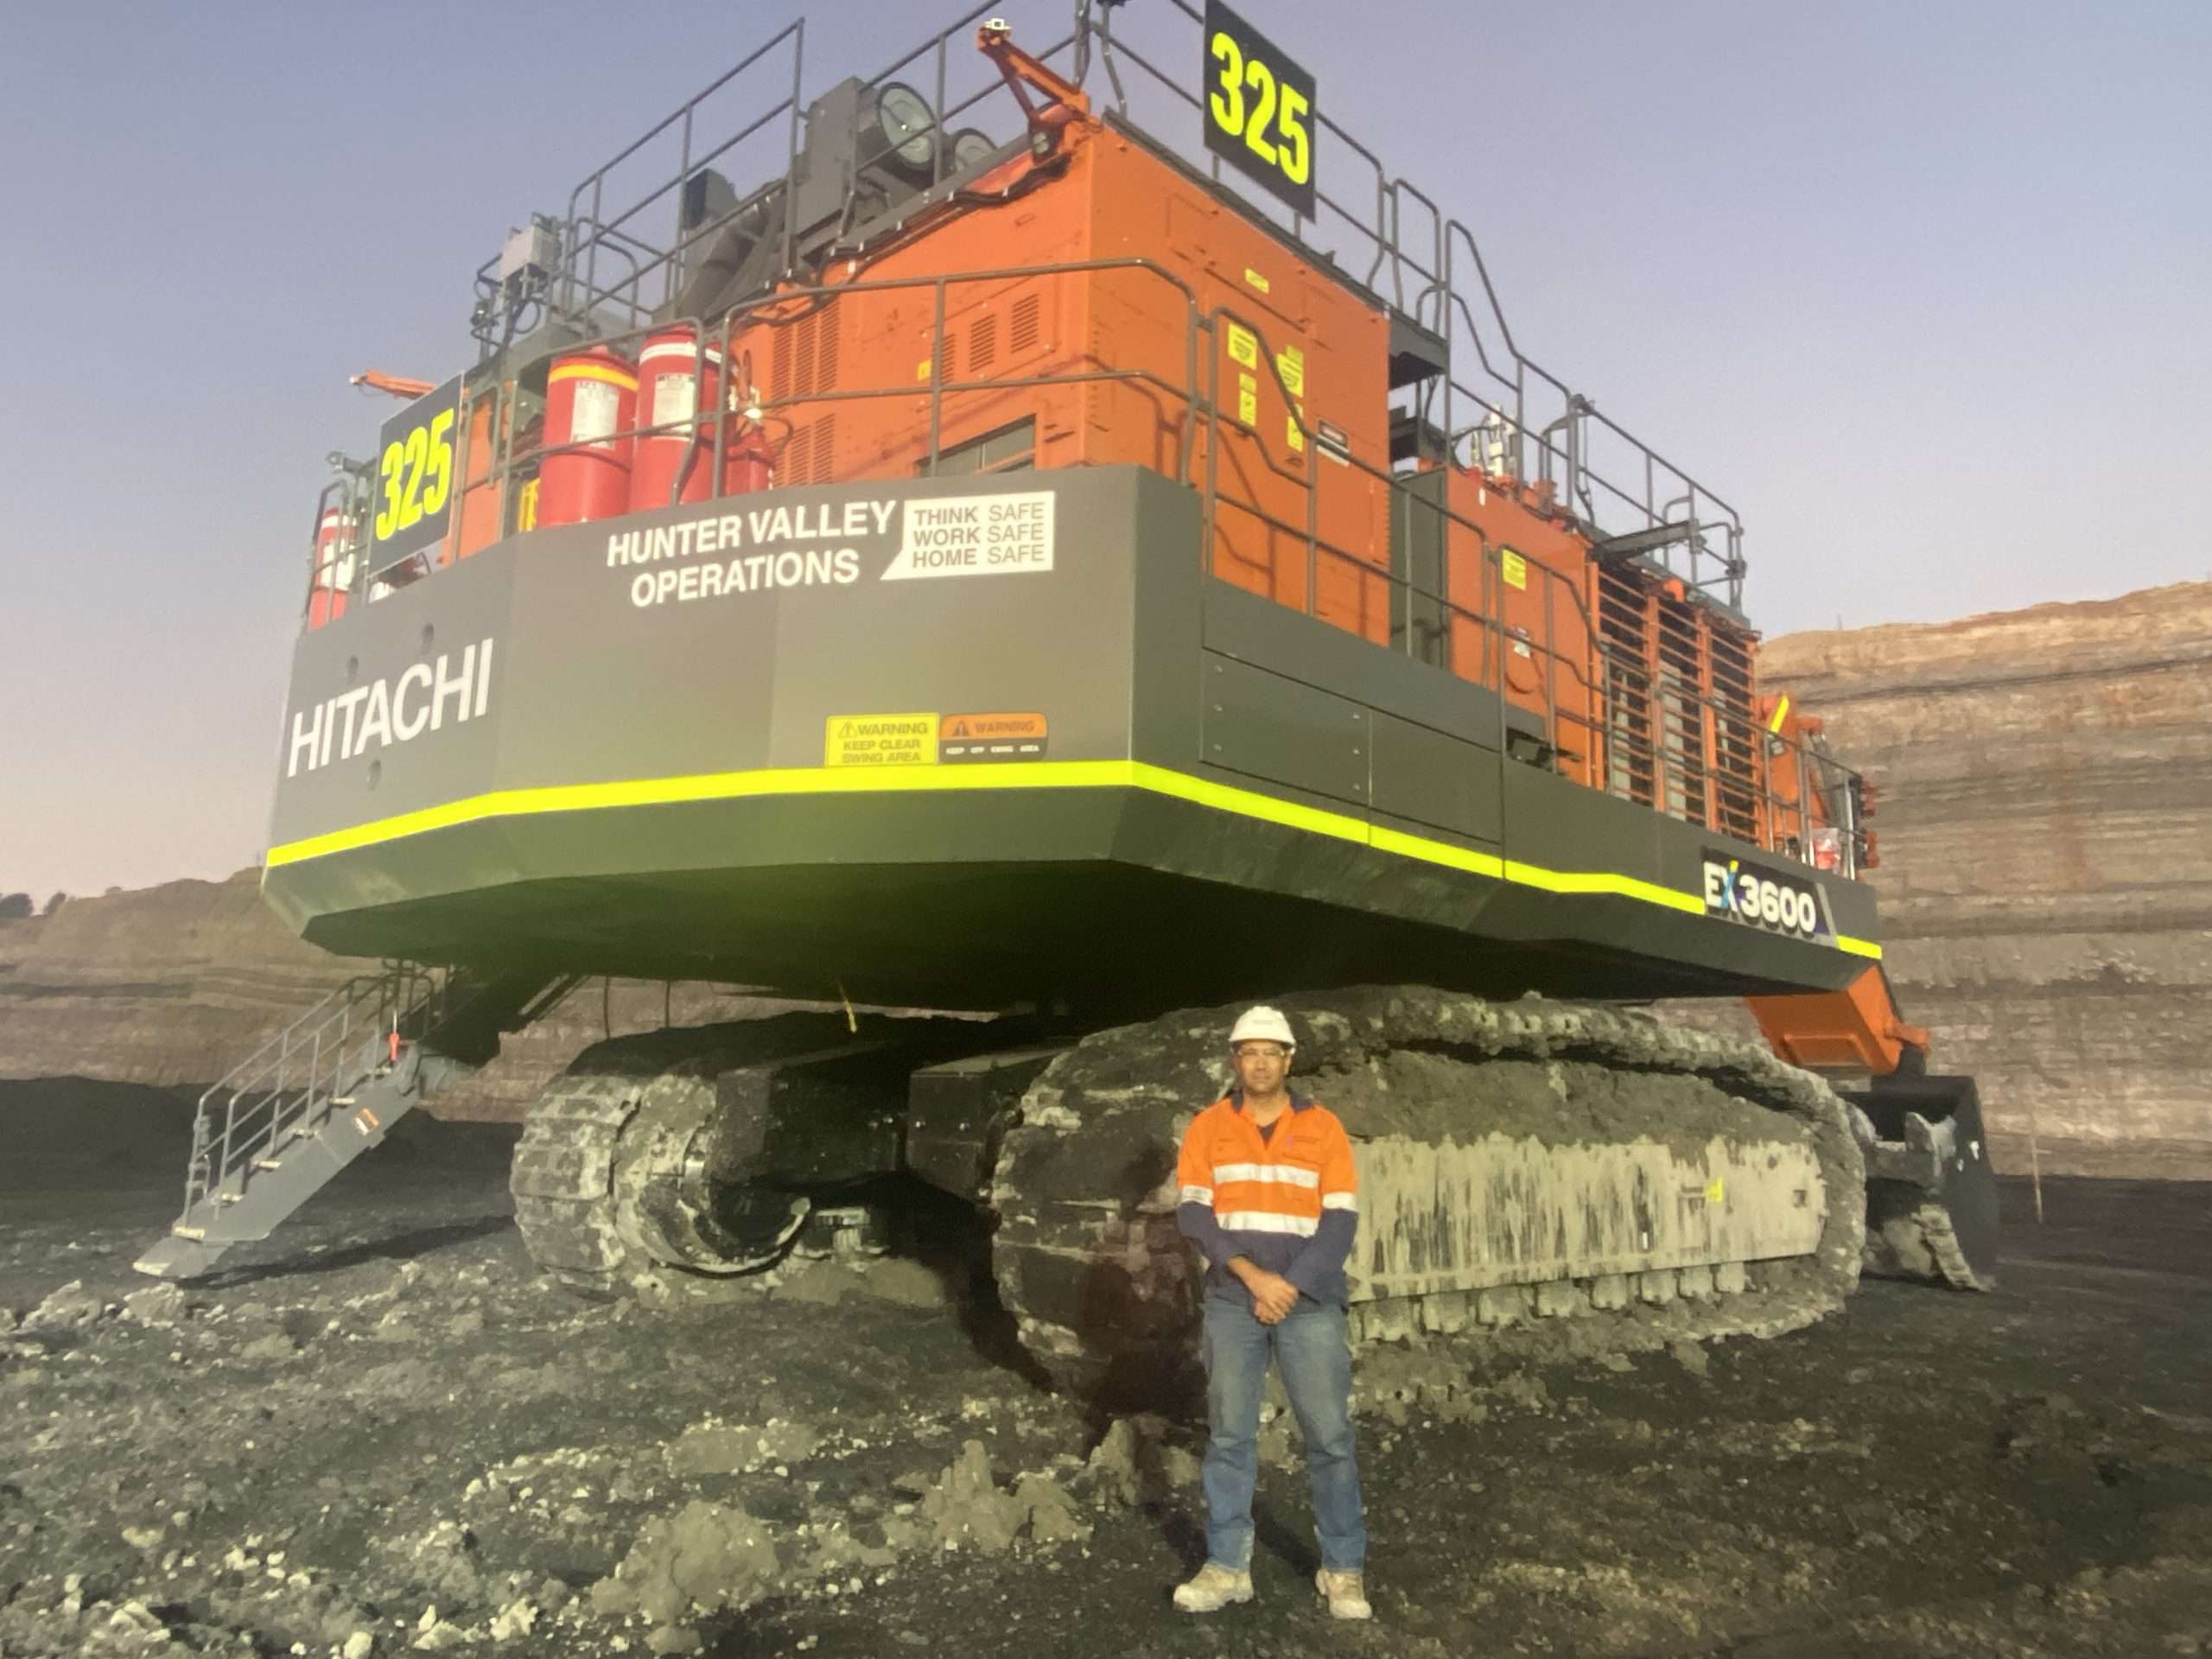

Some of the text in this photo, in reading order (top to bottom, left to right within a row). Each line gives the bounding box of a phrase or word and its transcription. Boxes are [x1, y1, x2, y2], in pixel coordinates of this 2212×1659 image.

[1211, 31, 1309, 185] 325
[375, 407, 454, 542] 325
[607, 499, 897, 568] HUNTER VALLEY
[912, 522, 1045, 547] WORK SAFE
[914, 501, 1045, 526] THINK SAFE
[912, 543, 1045, 569] HOME SAFE
[631, 548, 861, 608] OPERATIONS
[287, 638, 494, 778] HITACHI
[857, 721, 928, 735] WARNING
[842, 752, 921, 764] SWING AREA
[843, 739, 920, 751] KEEP CLEAR
[1703, 860, 1816, 933] EX3600
